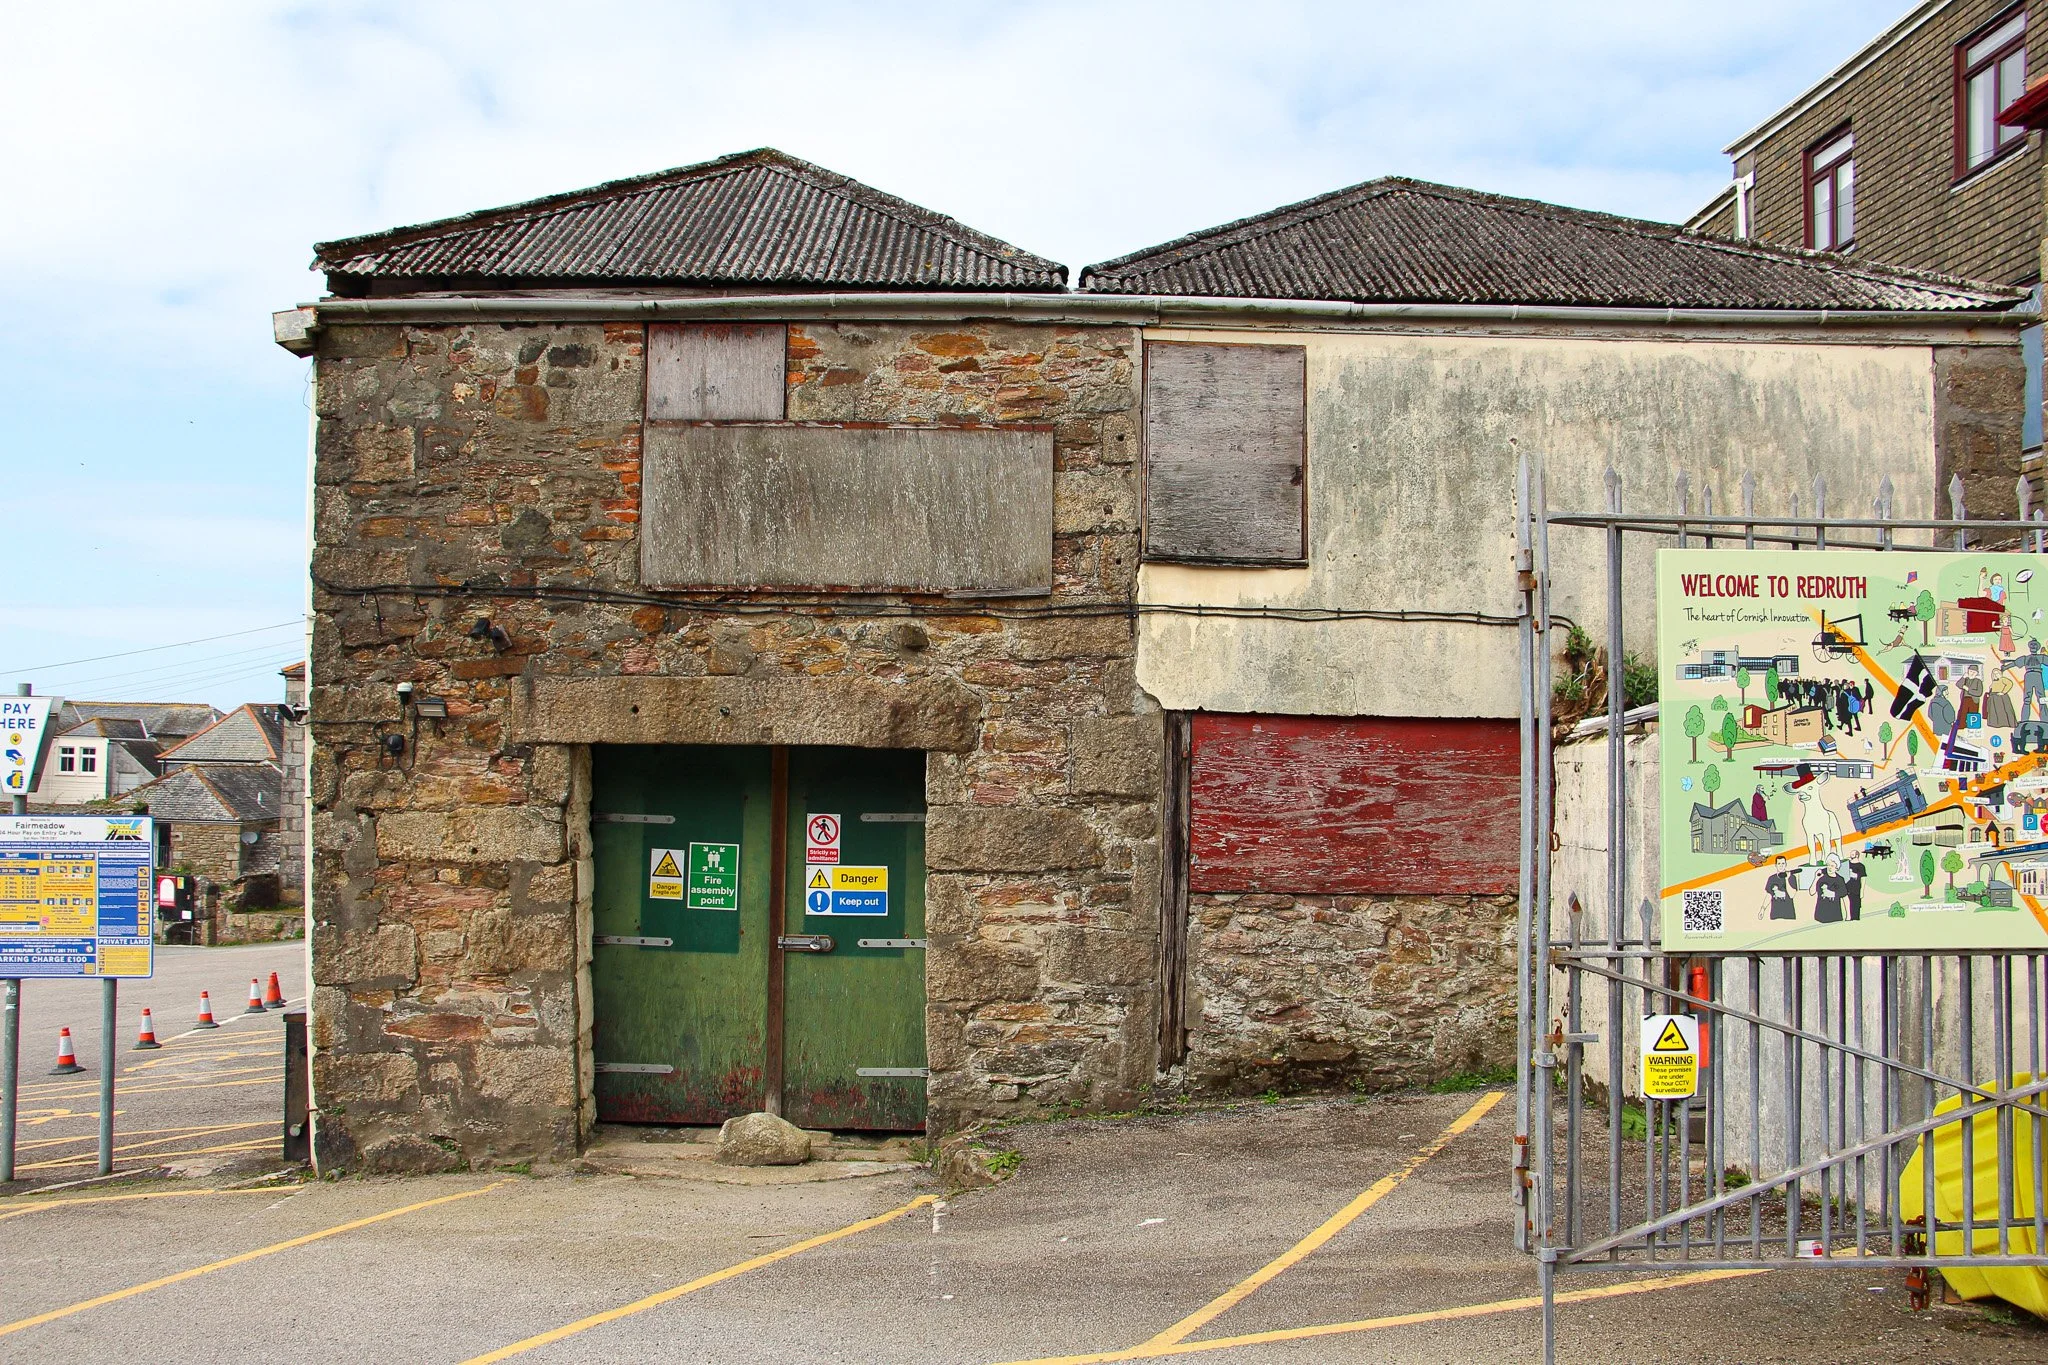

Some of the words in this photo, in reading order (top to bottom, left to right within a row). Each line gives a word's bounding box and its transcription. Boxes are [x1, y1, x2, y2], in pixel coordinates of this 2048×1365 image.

[1681, 574, 1759, 597] WELCOME
[1767, 576, 1789, 598] TO
[1797, 576, 1867, 599] REDRUTH
[1683, 607, 1700, 622] The
[1701, 608, 1726, 622] heart
[1726, 609, 1737, 623] of
[1737, 609, 1768, 623] Cornish
[1770, 609, 1811, 623] Innovation
[3, 703, 31, 714] PAY
[0, 718, 36, 729] HERE
[2026, 817, 2034, 828] P
[704, 875, 722, 884] Fire
[841, 874, 878, 886] Danger
[691, 887, 734, 897] assembly
[700, 897, 724, 906] point
[839, 897, 862, 907] Keep
[864, 898, 879, 906] out
[1648, 1056, 1693, 1065] WARNING
